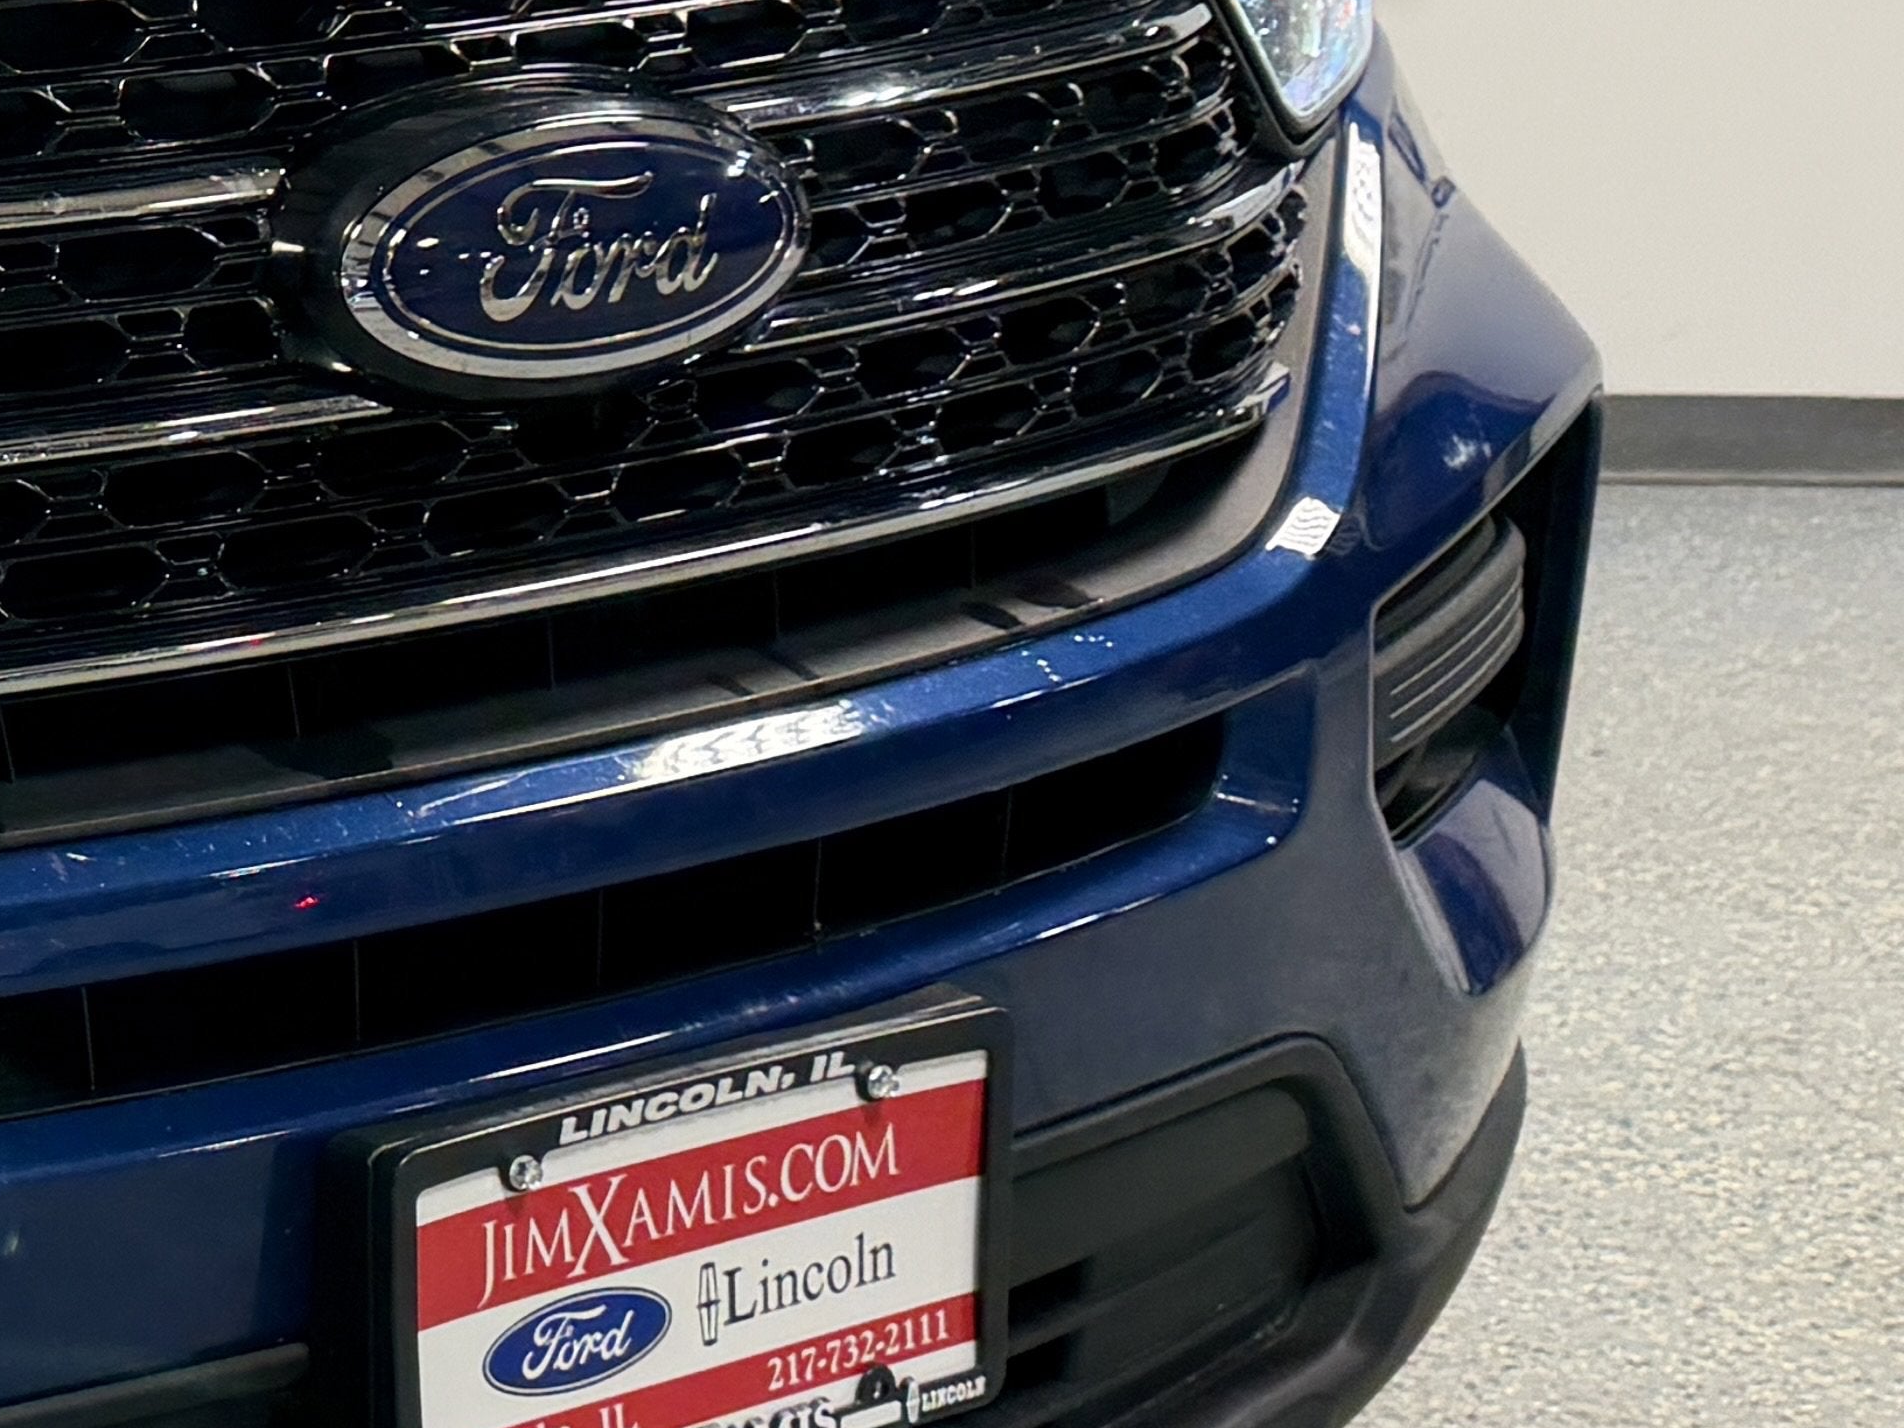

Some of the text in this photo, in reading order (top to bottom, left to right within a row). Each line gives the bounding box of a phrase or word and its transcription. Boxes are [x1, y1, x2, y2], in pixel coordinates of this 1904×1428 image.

[480, 171, 718, 322] Ford
[559, 1050, 855, 1145] LINCOLN, IL
[724, 1232, 897, 1327] Lincoln
[521, 1303, 633, 1380] Ford
[766, 1309, 950, 1394] 217-732-2111
[922, 1375, 987, 1413] LINCOLN
